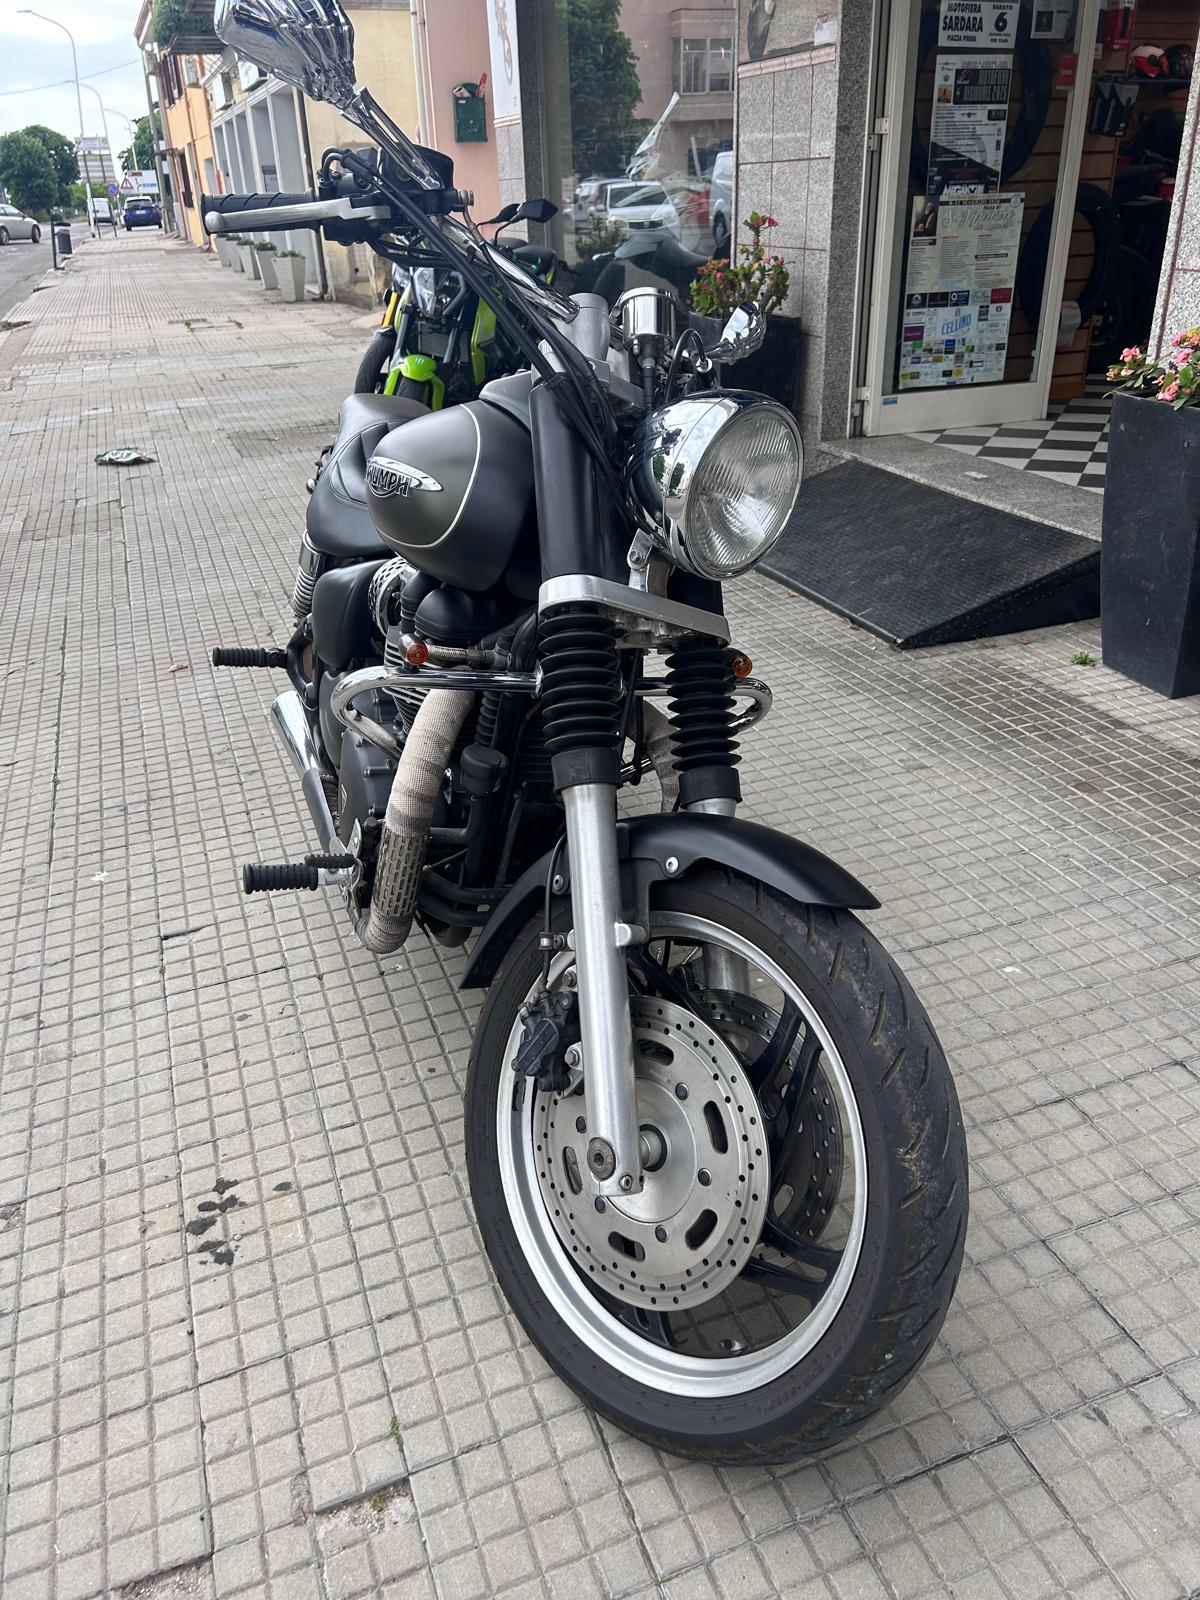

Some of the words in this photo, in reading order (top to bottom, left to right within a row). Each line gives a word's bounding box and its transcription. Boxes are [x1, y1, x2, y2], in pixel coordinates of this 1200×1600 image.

[947, 3, 982, 13] MOTOFIERA
[942, 15, 983, 32] SARDARA
[994, 12, 1008, 32] 6
[947, 34, 962, 42] PIAZZA
